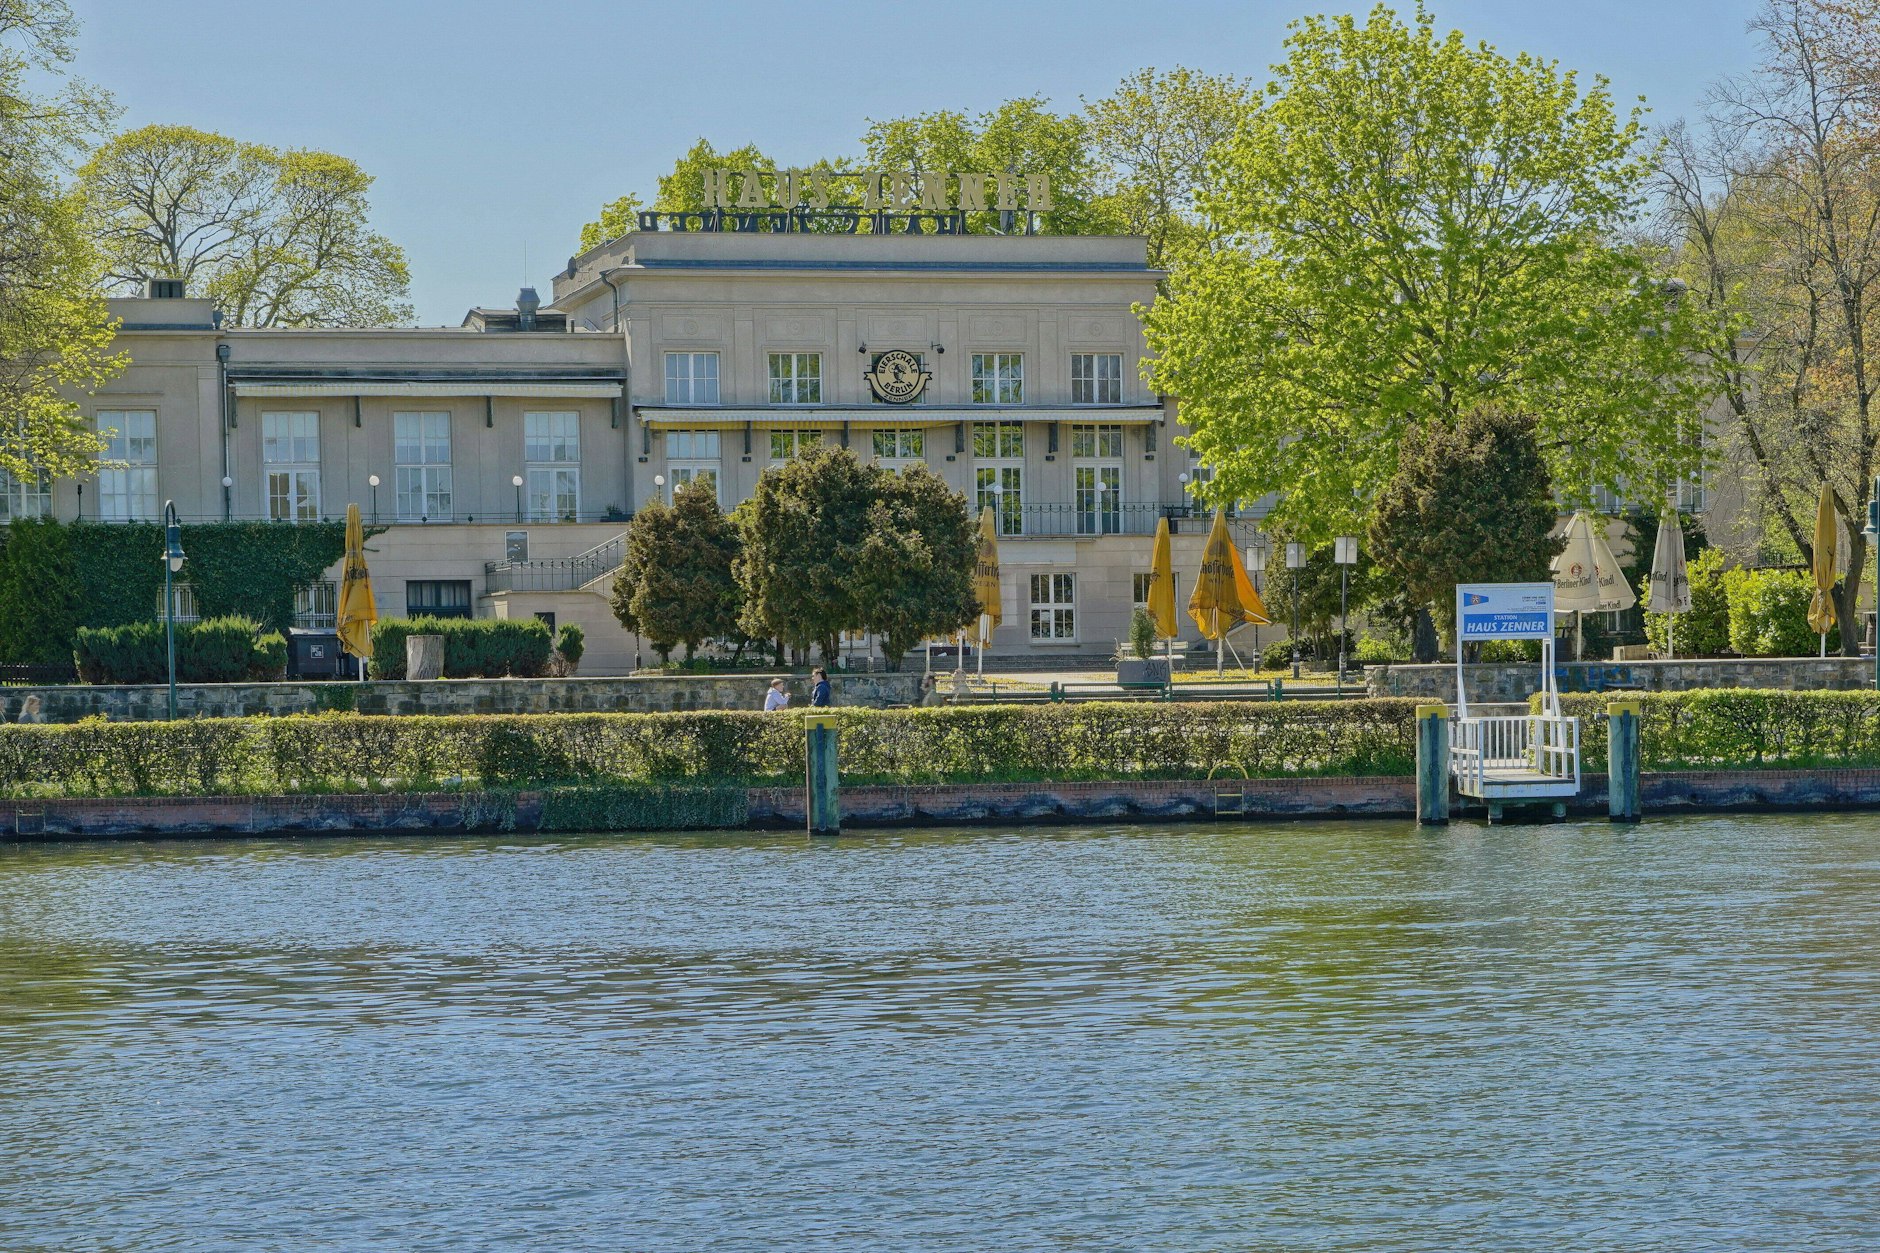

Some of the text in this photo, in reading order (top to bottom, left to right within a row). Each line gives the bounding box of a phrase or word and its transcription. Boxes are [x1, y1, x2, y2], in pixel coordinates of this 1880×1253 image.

[700, 168, 1054, 211] HAUS ZENNER
[879, 353, 917, 374] EIERSCHALE
[884, 381, 913, 394] BERLIN
[1557, 579, 1578, 589] Berliner
[1599, 575, 1615, 588] Kindl
[1467, 621, 1545, 632] HAUS ZENNER
